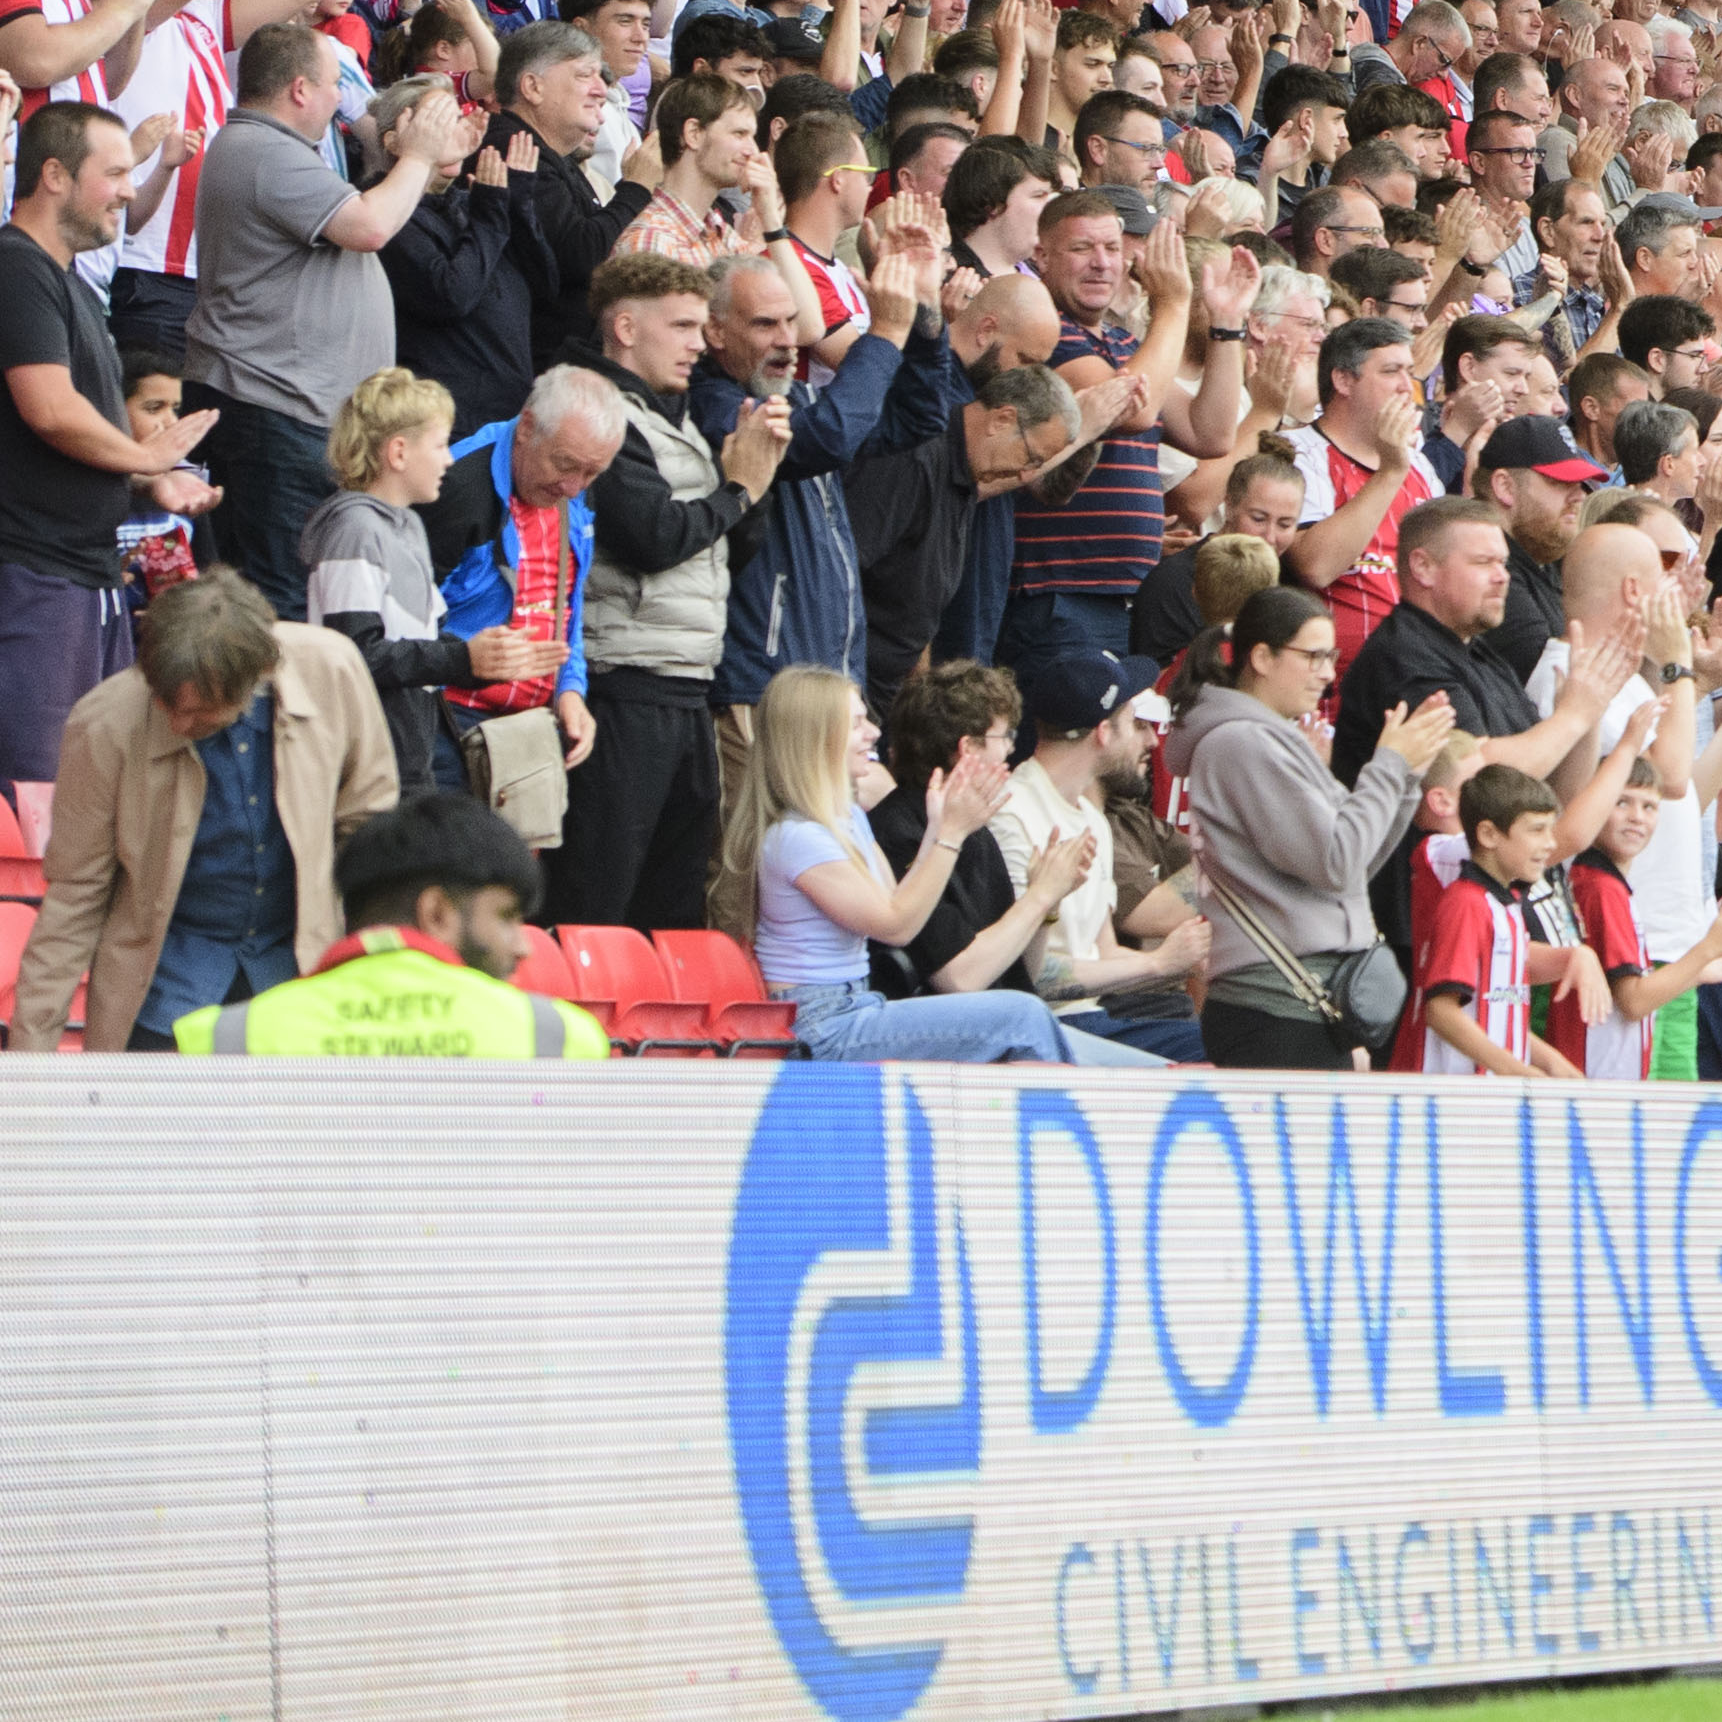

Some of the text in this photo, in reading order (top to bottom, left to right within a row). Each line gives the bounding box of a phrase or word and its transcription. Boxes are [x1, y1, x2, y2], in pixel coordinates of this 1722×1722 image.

[337, 992, 455, 1020] SAFETY
[321, 1031, 473, 1055] STEWARD
[1057, 1531, 1258, 1694] CIVIL
